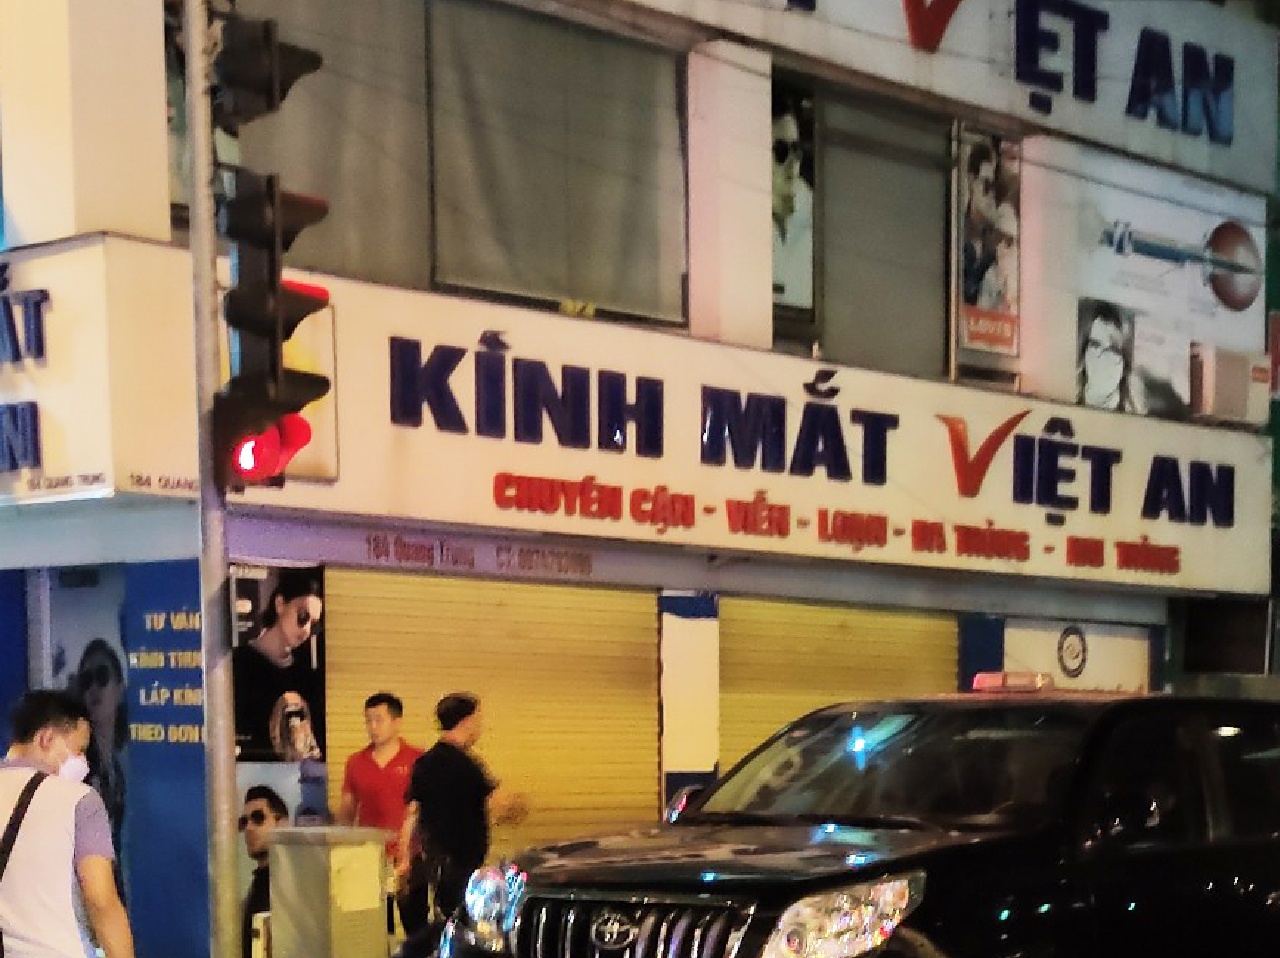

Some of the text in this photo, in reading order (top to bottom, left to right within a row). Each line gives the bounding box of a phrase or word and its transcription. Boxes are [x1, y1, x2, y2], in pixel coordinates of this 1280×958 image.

[1126, 27, 1235, 145] AN
[389, 331, 1235, 527] KÍNH MẮT VIỆT AN
[494, 471, 624, 521] CHUYÊN
[629, 485, 695, 535] CẬN
